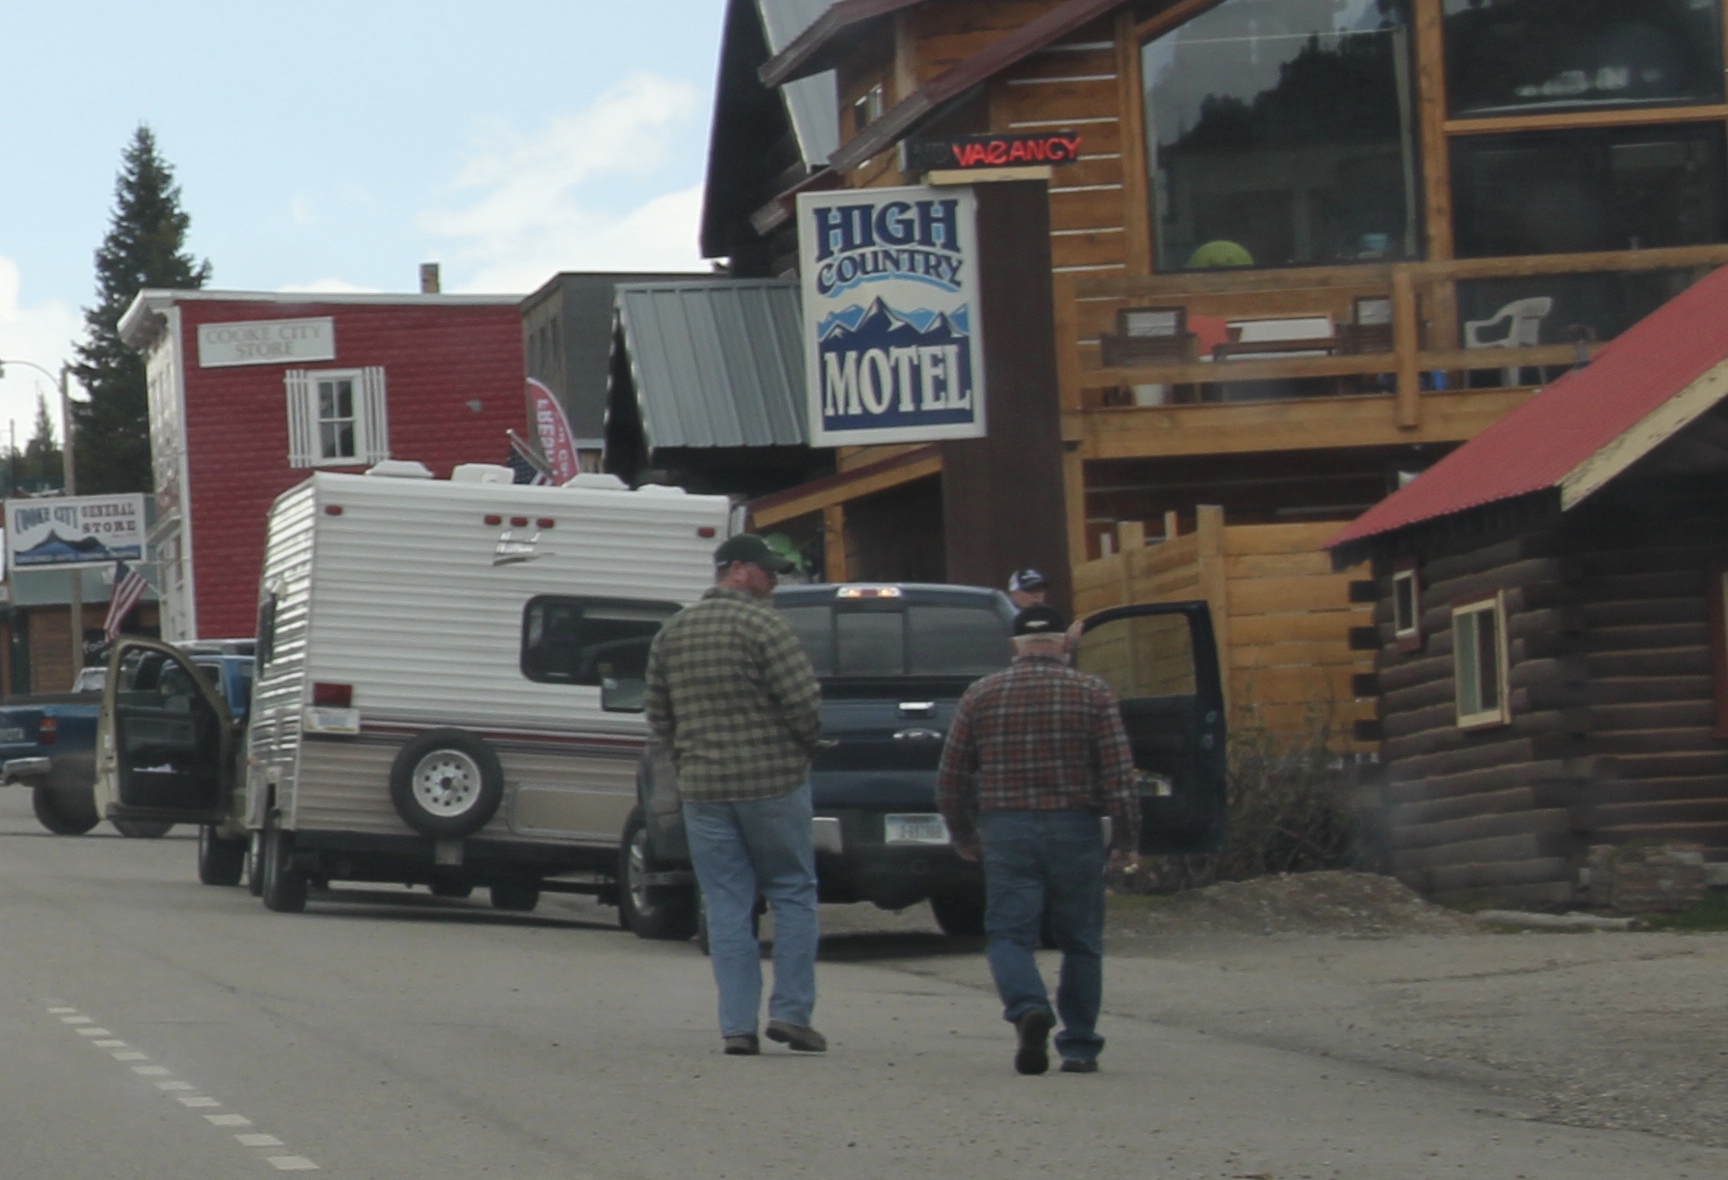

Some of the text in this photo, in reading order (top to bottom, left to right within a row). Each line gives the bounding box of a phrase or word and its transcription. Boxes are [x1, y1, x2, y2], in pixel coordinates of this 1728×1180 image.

[952, 136, 1083, 168] VACANCY
[813, 199, 962, 263] HIGH
[815, 248, 964, 296] COUNTRY
[205, 323, 322, 345] COOKE CITY
[234, 341, 294, 358] STORE
[824, 344, 972, 417] MOTEL
[14, 505, 78, 535] COOKE CITY
[81, 502, 136, 518] GENERAL
[81, 520, 137, 534] STORE
